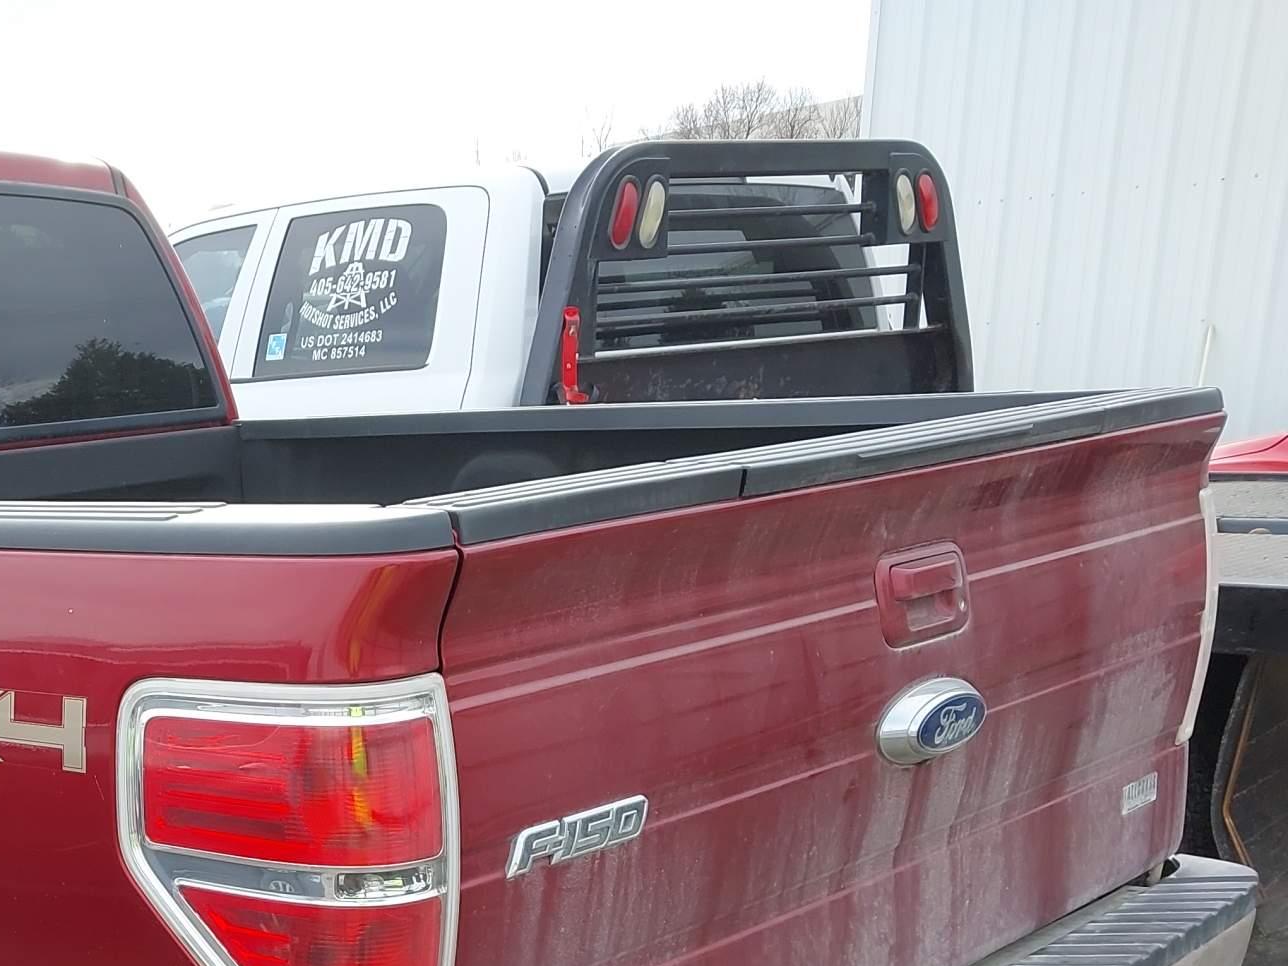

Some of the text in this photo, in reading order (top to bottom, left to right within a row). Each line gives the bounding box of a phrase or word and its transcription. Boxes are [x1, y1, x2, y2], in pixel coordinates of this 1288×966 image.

[309, 218, 412, 275] KMD
[309, 269, 397, 296] 405-642-9581
[299, 301, 334, 329] HOTSHOT
[380, 291, 398, 314] LLC
[300, 335, 315, 349] US
[316, 334, 340, 347] DOT
[340, 329, 383, 345] 2414683
[312, 344, 366, 360] MC 857514
[934, 702, 977, 745] Ford
[506, 795, 648, 879] F-150
